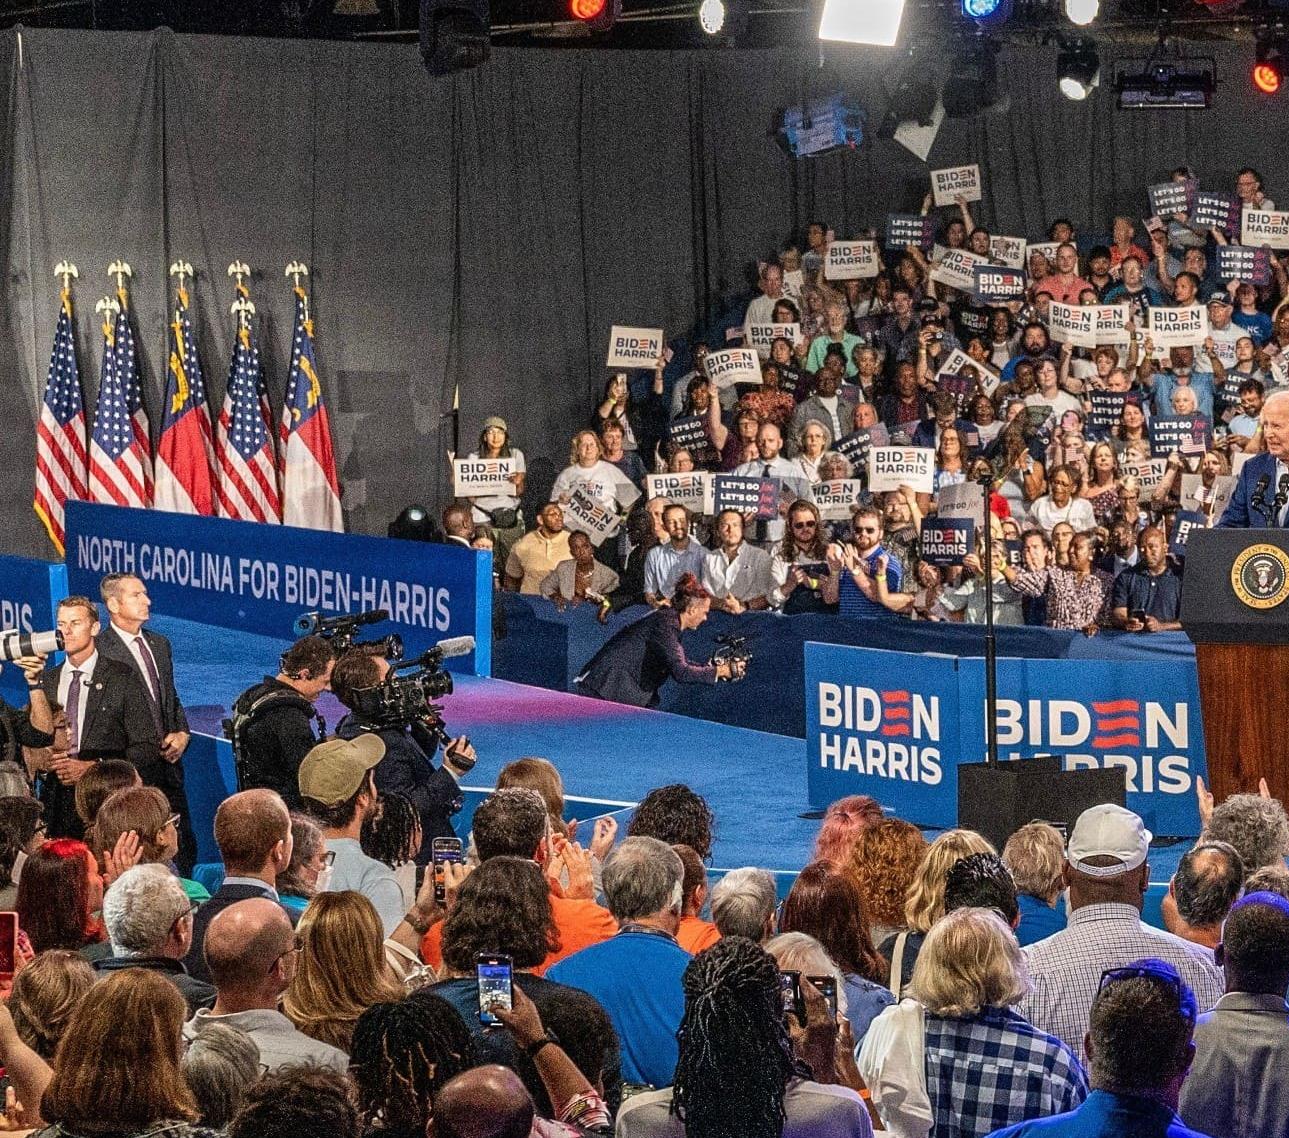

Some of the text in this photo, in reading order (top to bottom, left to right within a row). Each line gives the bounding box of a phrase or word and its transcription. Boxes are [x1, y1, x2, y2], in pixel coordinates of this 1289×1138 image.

[937, 169, 976, 182] BIDEN
[938, 180, 977, 192] HARRIS
[1247, 213, 1289, 226] BIDEN
[1246, 224, 1289, 235] HARRIS
[830, 245, 871, 257] BIDEN
[830, 255, 873, 266] HARRIS
[979, 273, 1023, 285] BIDEN
[979, 285, 1024, 295] HARRIS
[1053, 305, 1091, 322] BIDEN
[1154, 310, 1201, 322] BIDEN
[1052, 318, 1090, 331] HARRIS
[1154, 321, 1201, 332] HARRIS
[751, 327, 794, 336] BIDEN
[616, 338, 658, 350] BIDEN
[615, 348, 658, 360] HARRIS
[706, 352, 752, 369] BIDEN
[709, 362, 754, 378] HARRIS
[1154, 421, 1192, 430] LET'S GO
[876, 452, 927, 464] BIDEN
[460, 463, 509, 473] BIDEN
[876, 463, 927, 475] HARRIS
[460, 473, 511, 483] HARRIS
[654, 476, 702, 488] BIDEN
[721, 481, 744, 489] LET'S
[721, 493, 744, 501] LET'S
[923, 530, 967, 543] BIDEN
[922, 544, 967, 556] HARRIS
[76, 534, 451, 632] NORTH CAROLINA FOR BIDEN-HARRIS
[819, 682, 940, 742] BIDEN
[985, 699, 1189, 749] BIDEN
[820, 733, 943, 785] HARRIS
